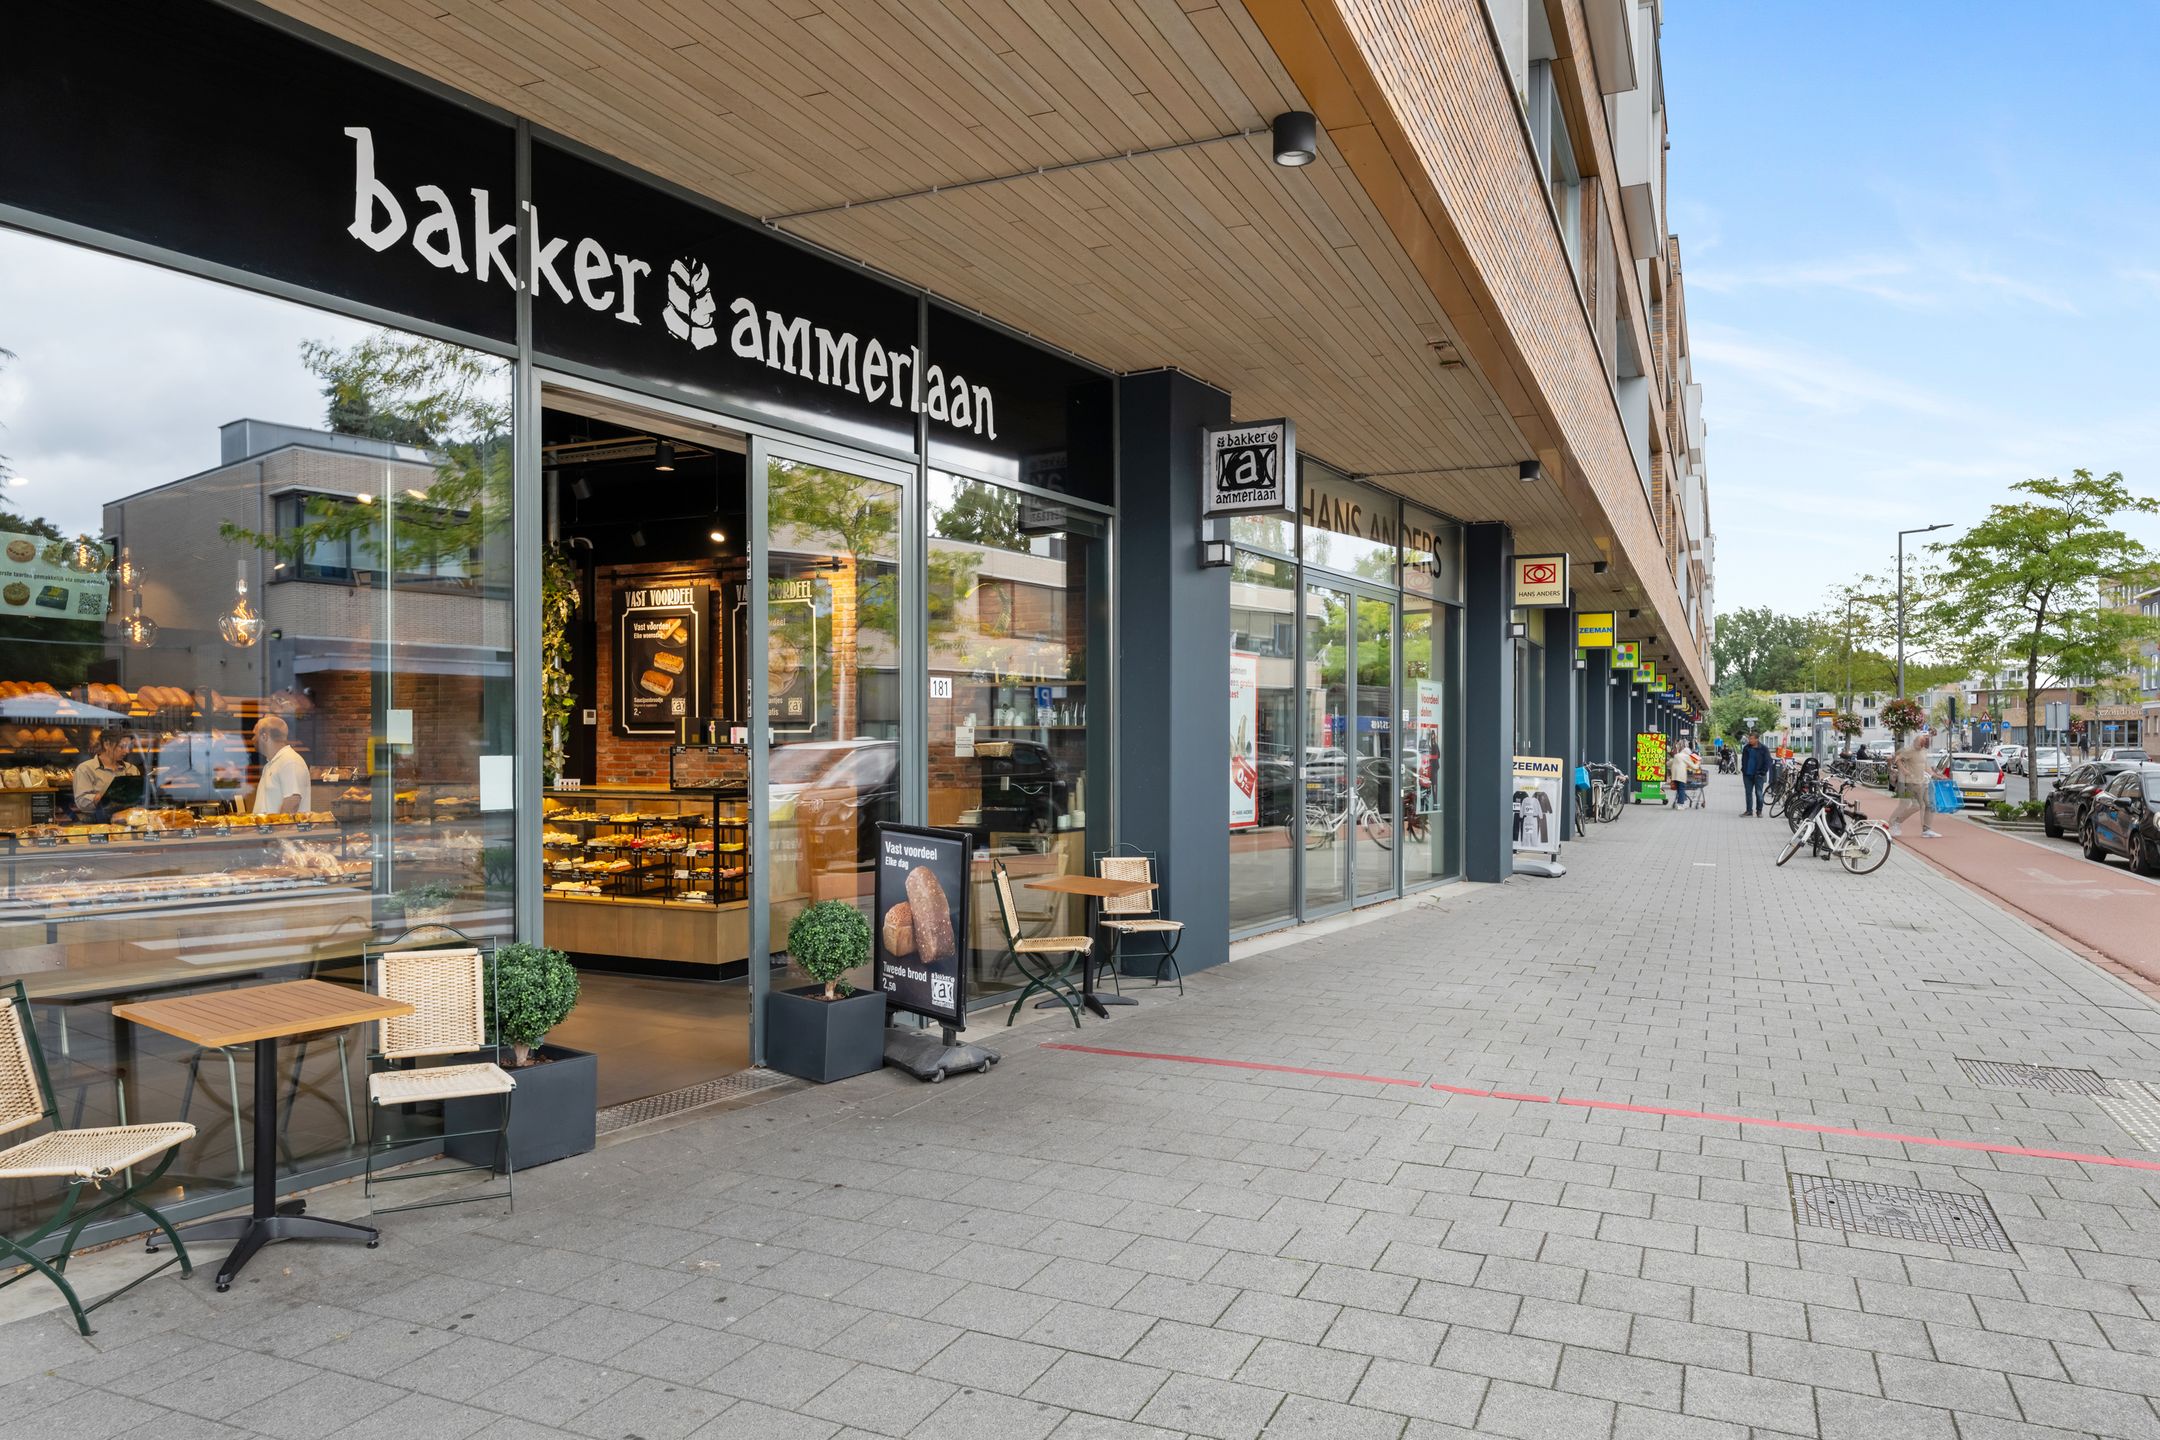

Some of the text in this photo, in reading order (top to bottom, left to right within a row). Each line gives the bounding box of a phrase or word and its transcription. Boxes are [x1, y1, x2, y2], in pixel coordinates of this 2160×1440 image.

[343, 126, 997, 441] bakker ammerlaan
[1227, 432, 1266, 447] bakker
[1216, 489, 1276, 504] ammerlaan
[625, 588, 695, 607] VAST VOORDEEL
[768, 580, 813, 600] OORDEEL
[933, 681, 948, 696] 181
[1513, 761, 1559, 772] ZEEMAN
[885, 841, 938, 860] Vast voordeel
[885, 856, 909, 870] Elke dag
[882, 961, 927, 982] Tweede brood
[882, 977, 897, 991] 2,50
